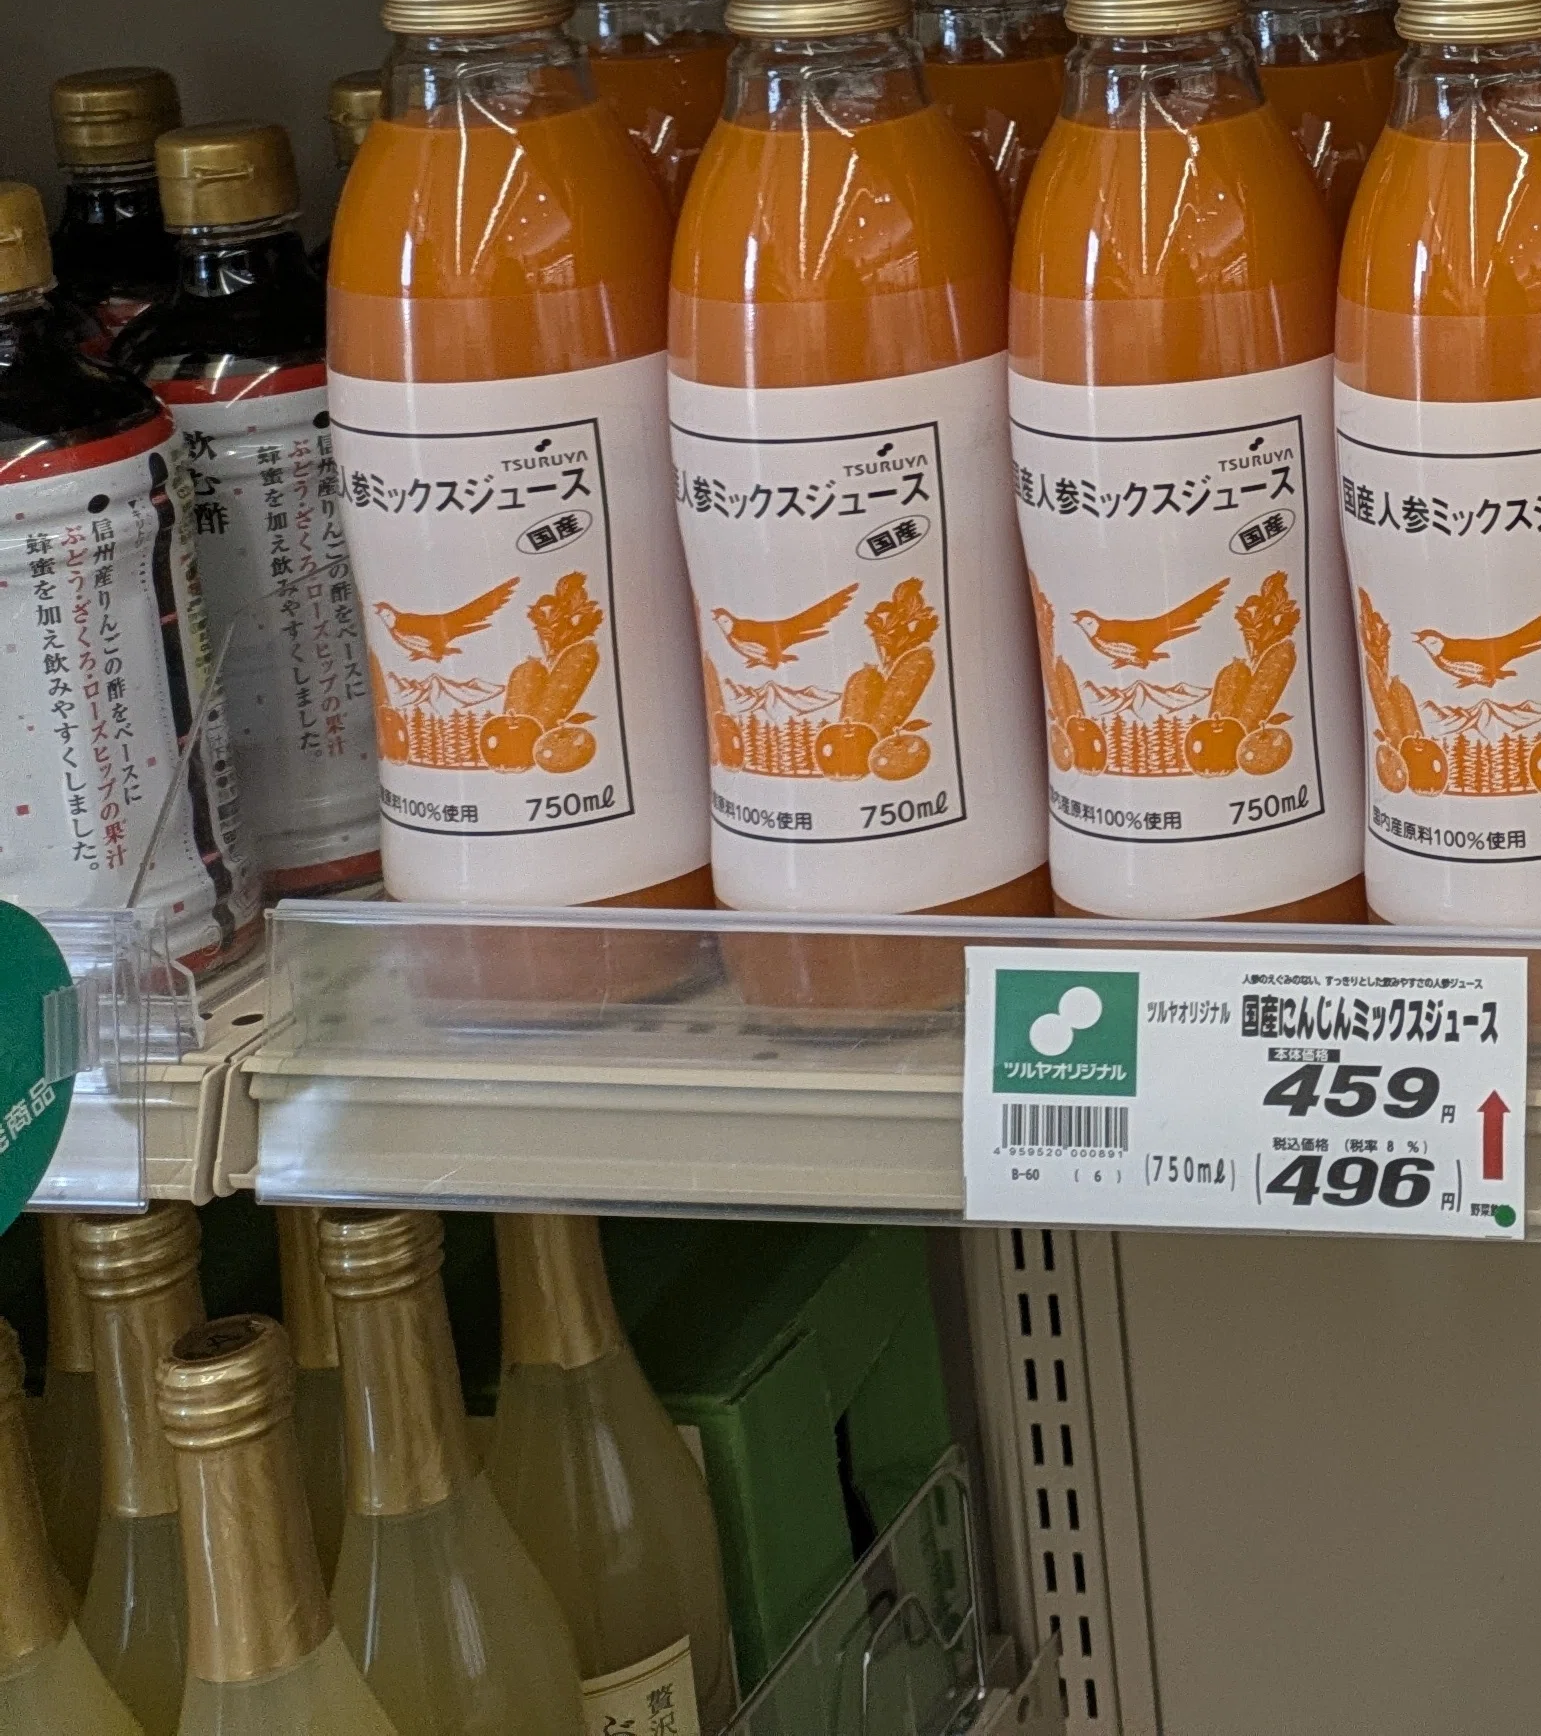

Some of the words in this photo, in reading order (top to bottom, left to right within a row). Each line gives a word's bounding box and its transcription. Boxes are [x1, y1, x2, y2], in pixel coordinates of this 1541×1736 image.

[502, 450, 588, 472] TSURUYA
[843, 454, 928, 477] TSURUYA
[1218, 448, 1294, 472] TSURUYA
[526, 515, 585, 552] 国産
[866, 519, 923, 557] 国産
[1239, 514, 1288, 552] 国産
[91, 518, 142, 805] 信州産りんごの酢をベースに
[27, 532, 100, 873] 蜂蜜を加え飲みやすくしました。
[1373, 806, 1526, 850] 国内産原料100%使用
[1147, 1001, 1231, 1026] ツルヤオリジナル
[1242, 993, 1499, 1044] 国産にんじんミックスジュース
[1274, 1048, 1330, 1063] 本体価格
[1004, 1062, 1127, 1081] ツルヤオリジナル
[1273, 1136, 1329, 1153] 税込価格
